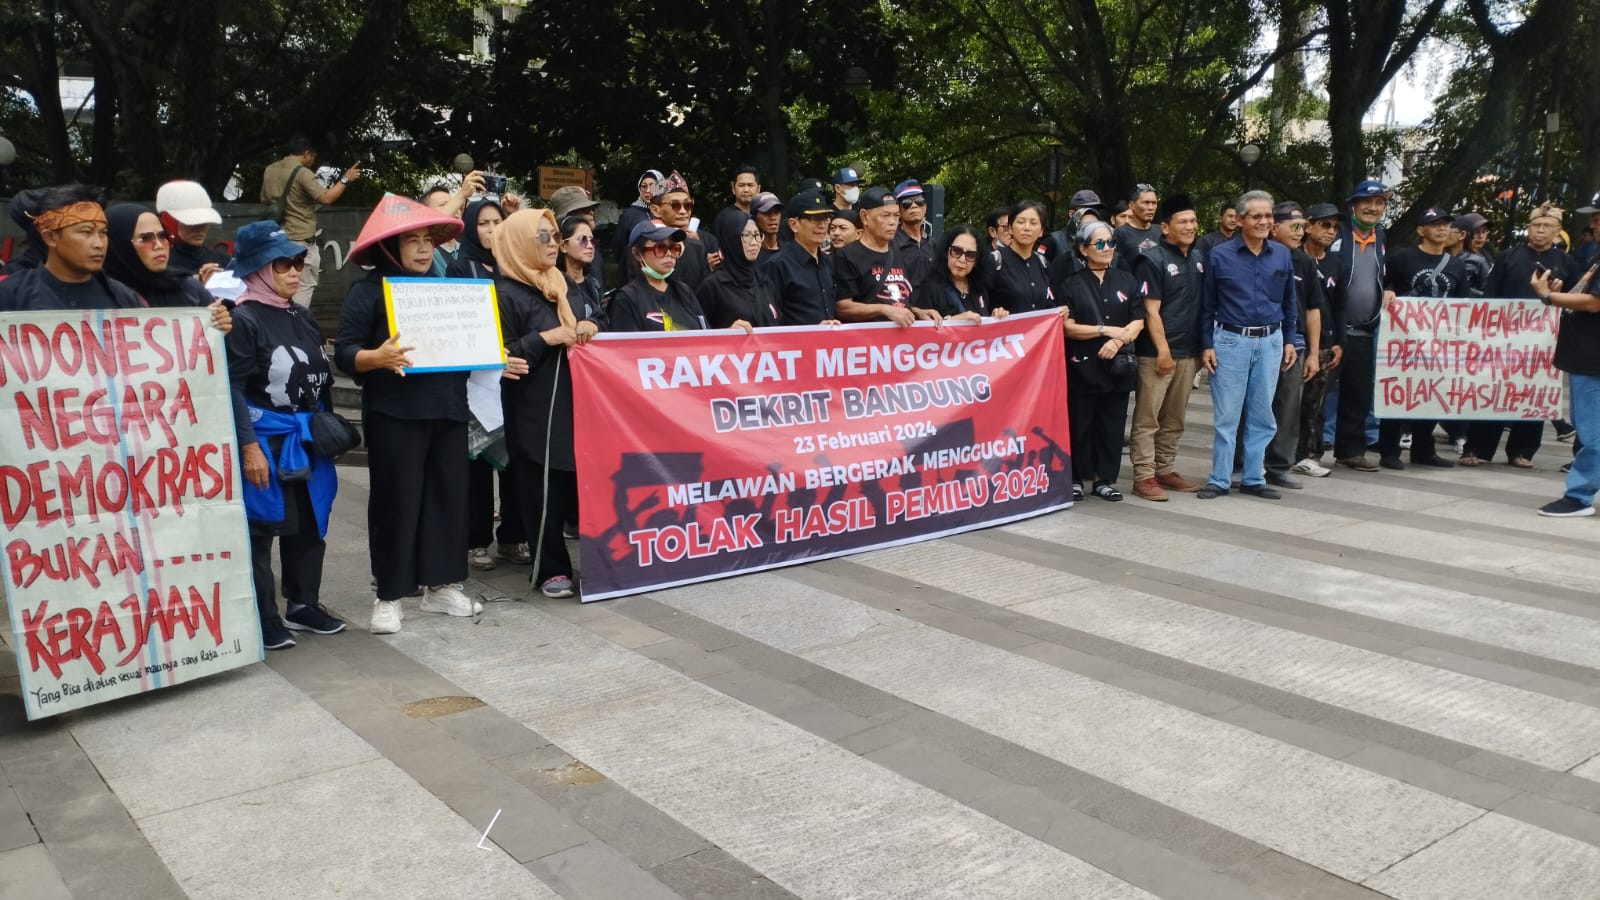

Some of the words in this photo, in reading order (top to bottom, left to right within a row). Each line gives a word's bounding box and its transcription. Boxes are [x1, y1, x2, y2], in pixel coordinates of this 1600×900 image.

[1387, 300, 1469, 339] RAKYAT
[0, 316, 214, 388] NDONESIA
[637, 349, 802, 390] RAKYAT
[815, 334, 1026, 378] MENGGUGAT
[1387, 339, 1467, 374] DEKRIT
[15, 378, 198, 450] NEGARA
[710, 391, 831, 433] DEKRIT
[843, 374, 991, 419] BANDUNG
[1380, 376, 1450, 414] TOLAK
[1447, 377, 1507, 415] HASIL
[1503, 381, 1561, 412] PEMILU
[1521, 408, 1559, 419] 2024
[794, 438, 815, 454] 23
[818, 427, 892, 451] Februari
[894, 423, 937, 442] 2024
[0, 443, 233, 531] DEMOKRASI
[667, 473, 796, 508] MELAWAN
[805, 457, 916, 488] BERGERAK
[923, 436, 1027, 470] MENGGUGAT
[629, 512, 763, 566] TOLAK
[775, 497, 876, 544] HASIL
[887, 474, 989, 524] PEMILU
[992, 464, 1050, 503] 2024
[22, 582, 221, 679] KERAJAAN
[30, 687, 61, 708] Yang
[61, 683, 81, 695] Bisa
[119, 669, 142, 683] sesuai
